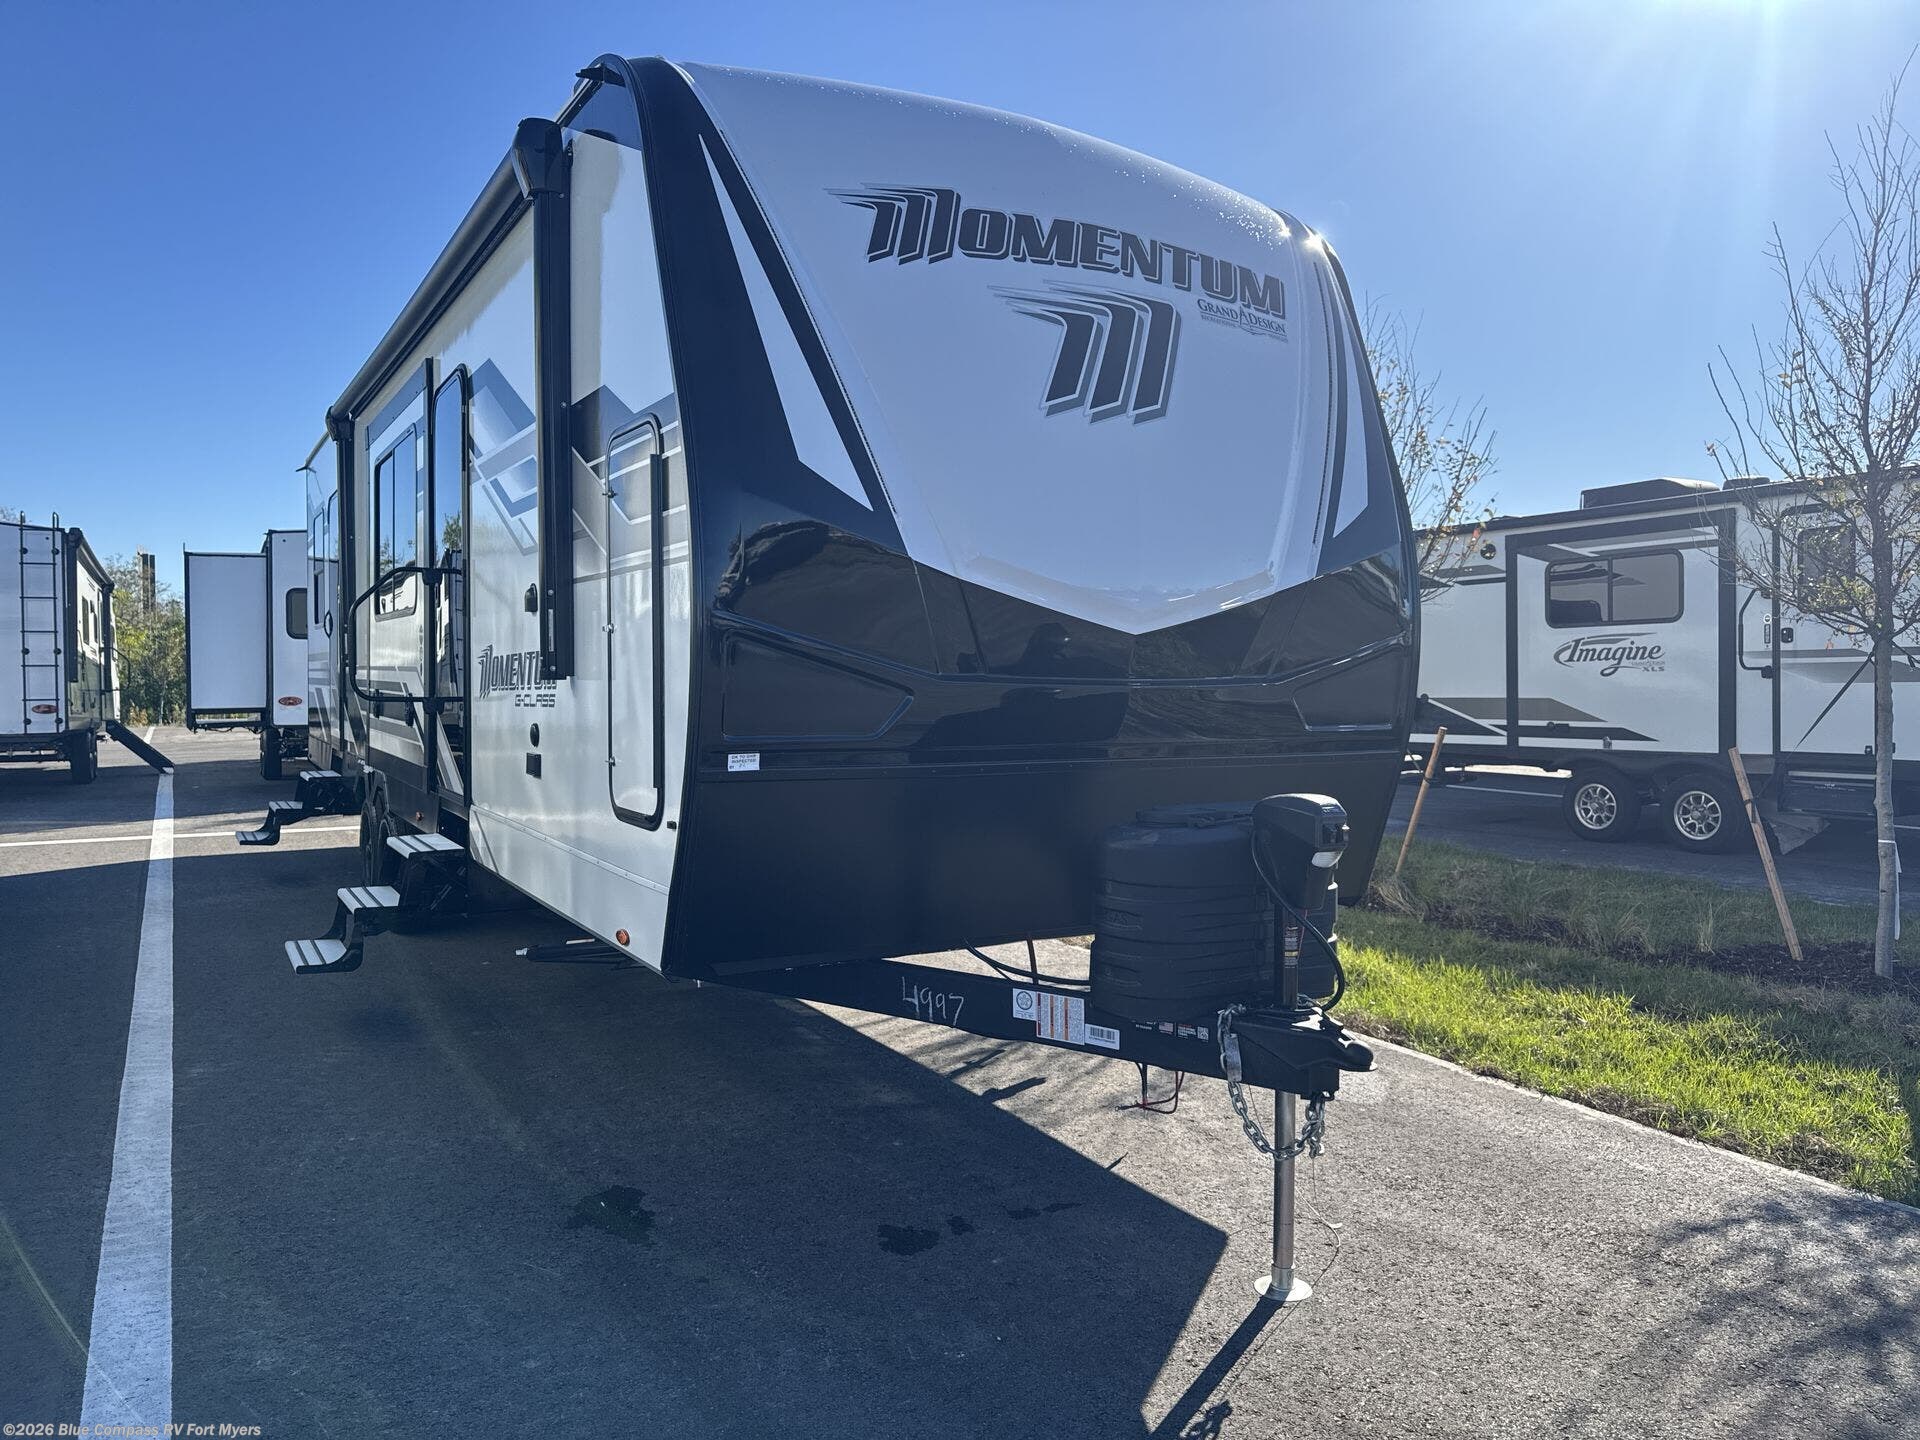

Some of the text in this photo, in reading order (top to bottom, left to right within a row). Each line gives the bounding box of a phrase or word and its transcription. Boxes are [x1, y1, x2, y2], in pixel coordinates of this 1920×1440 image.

[824, 182, 1287, 320] MOMENTUM
[1197, 298, 1286, 334] GRAND DESIGN
[477, 644, 557, 700] MOMENTU
[1561, 635, 1666, 677] Imagine
[901, 975, 965, 1029] 4997
